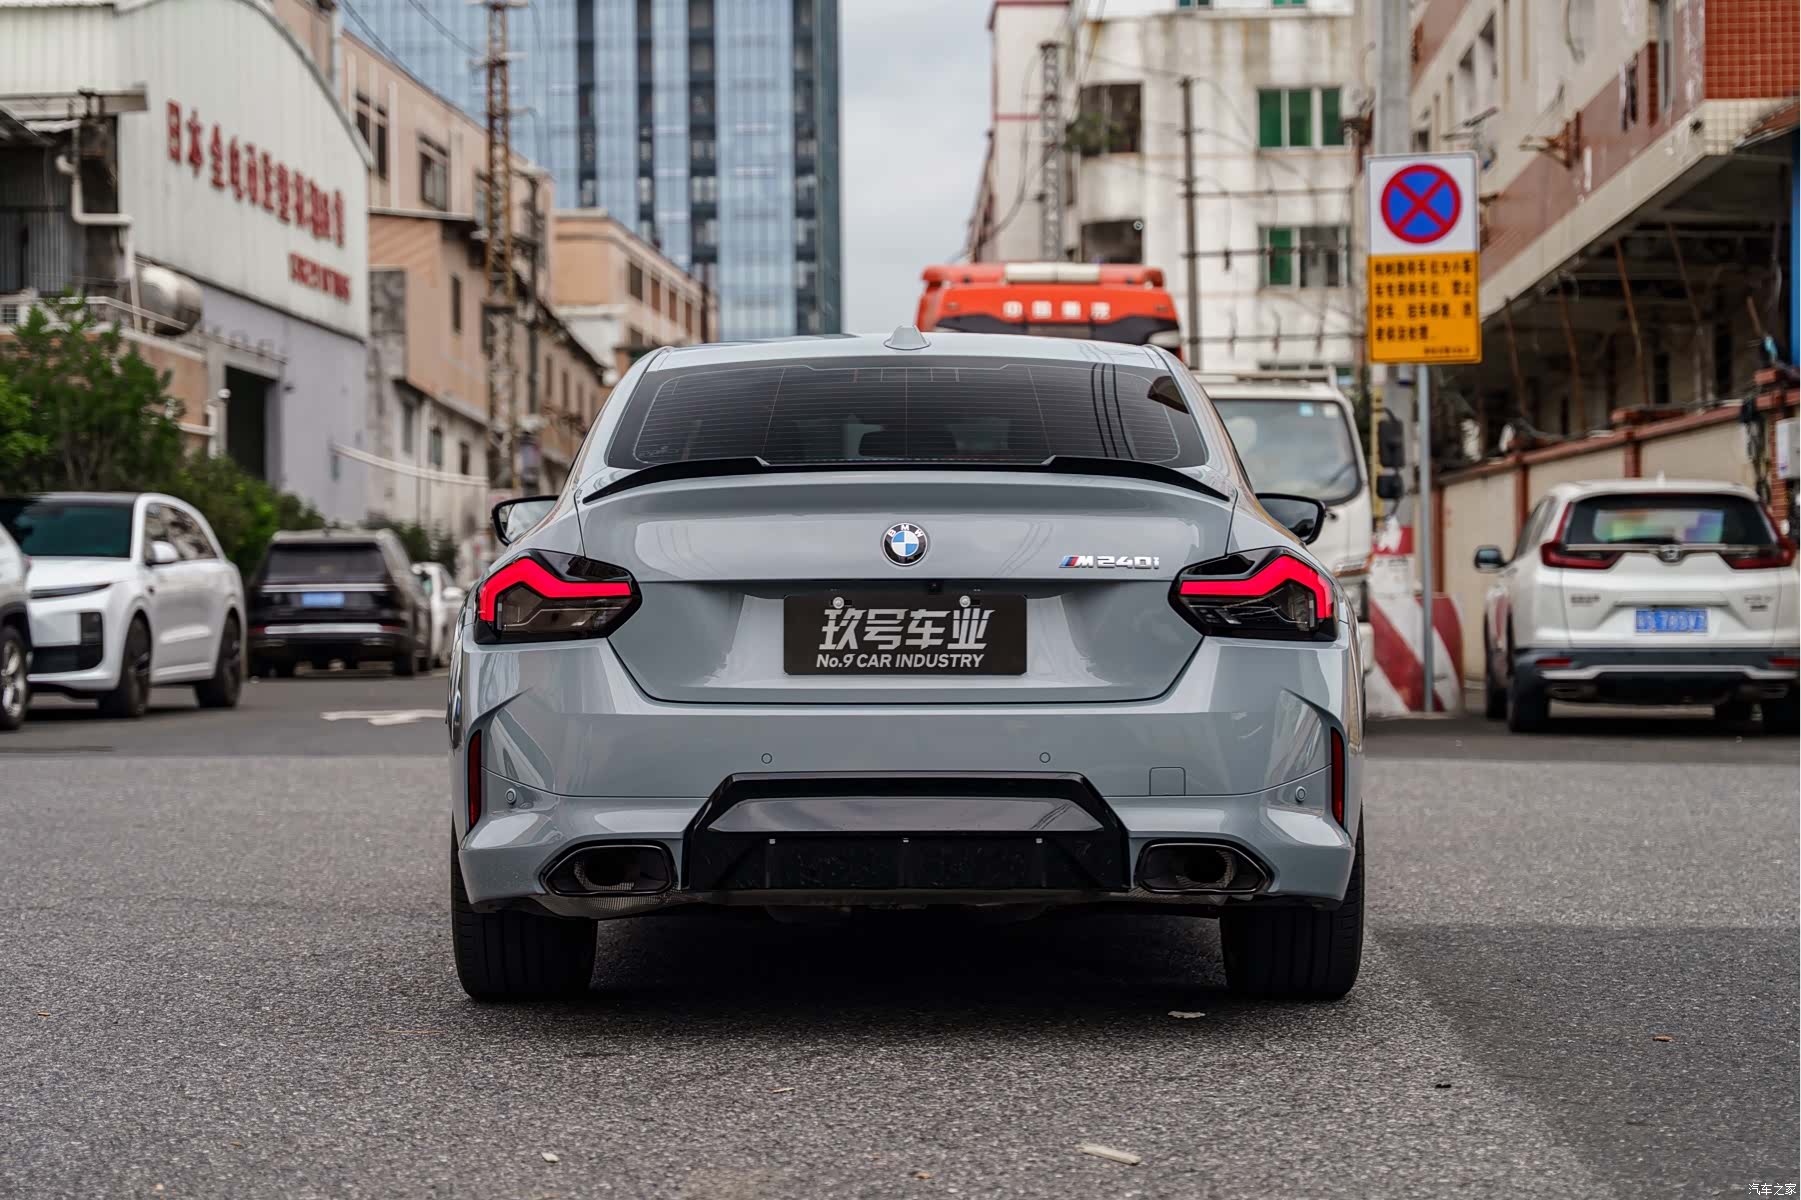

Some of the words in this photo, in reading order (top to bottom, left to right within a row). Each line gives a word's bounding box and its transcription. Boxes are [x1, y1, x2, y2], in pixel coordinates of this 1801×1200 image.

[818, 608, 996, 650] 玖号车业
[816, 653, 856, 668] No.9
[856, 653, 893, 668] CAR
[895, 653, 985, 668] INDUSTRY
